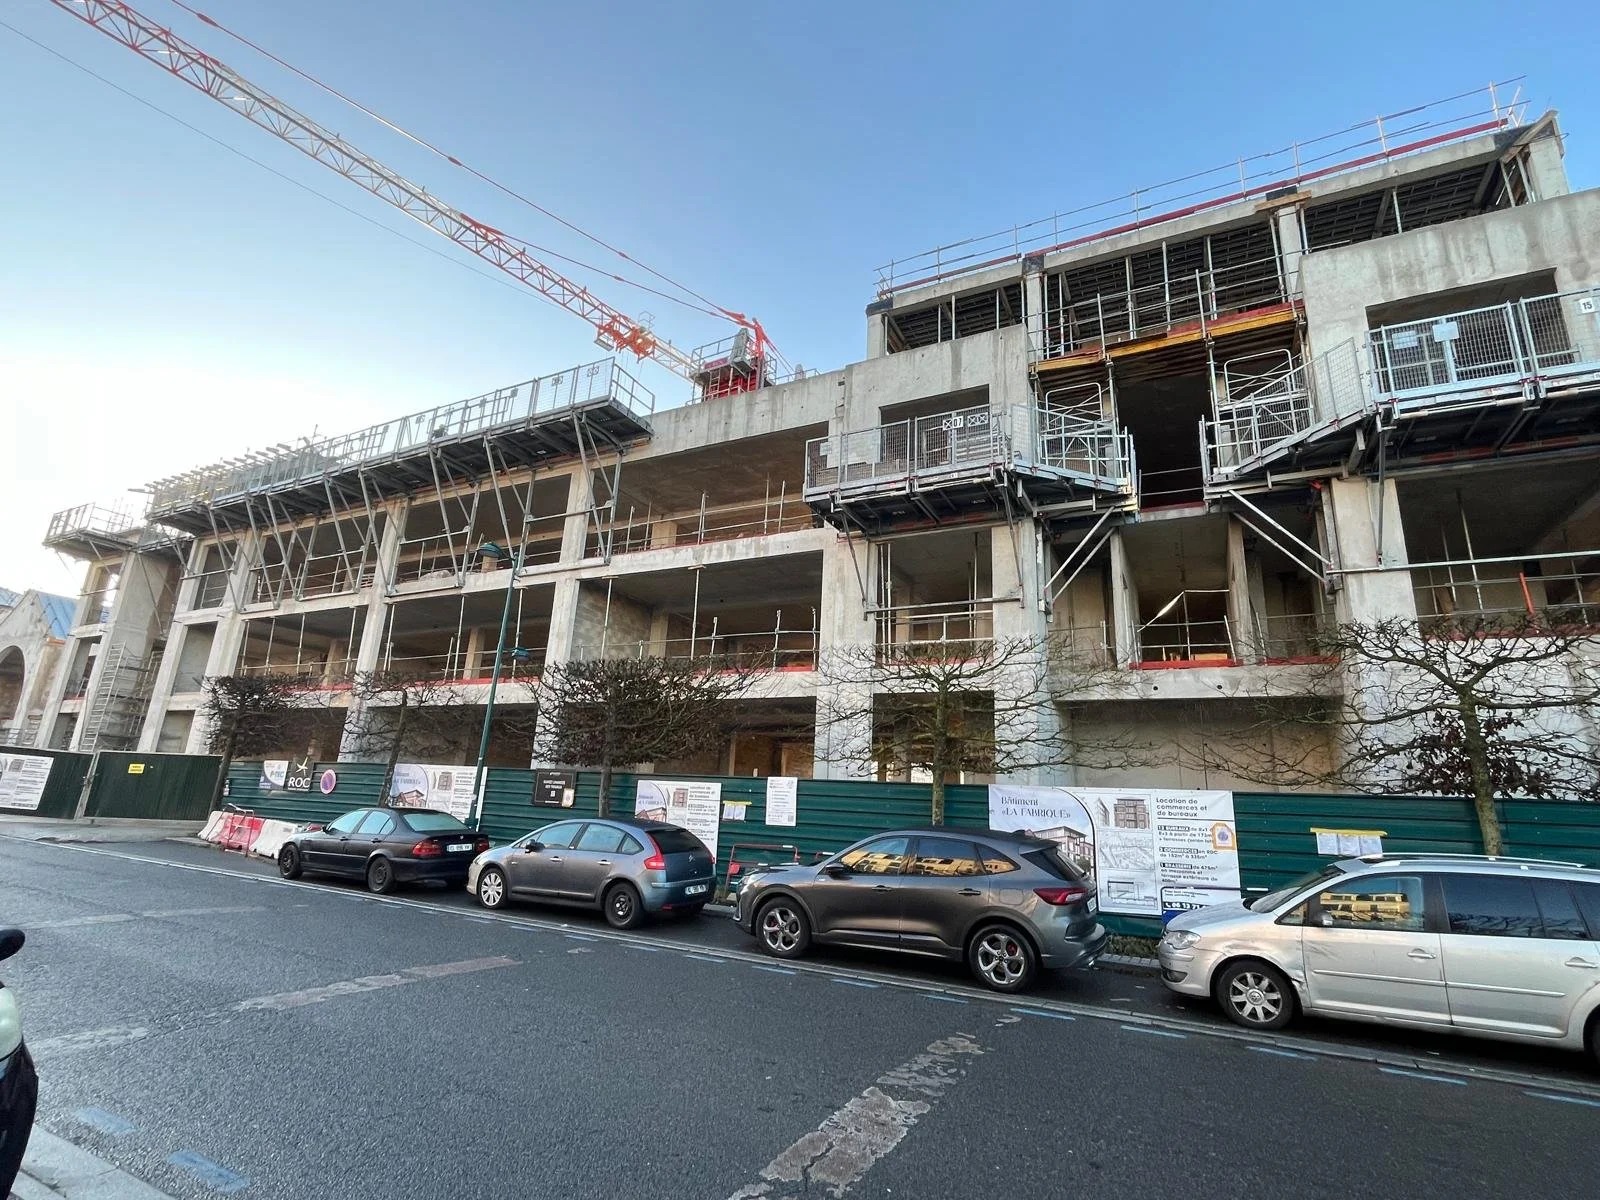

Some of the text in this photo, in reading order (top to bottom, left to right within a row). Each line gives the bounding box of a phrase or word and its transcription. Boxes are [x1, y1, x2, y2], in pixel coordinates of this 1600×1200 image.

[1582, 301, 1593, 310] 15
[953, 417, 962, 427] 07
[288, 777, 311, 788] ROC
[1001, 796, 1039, 806] Bâtiment
